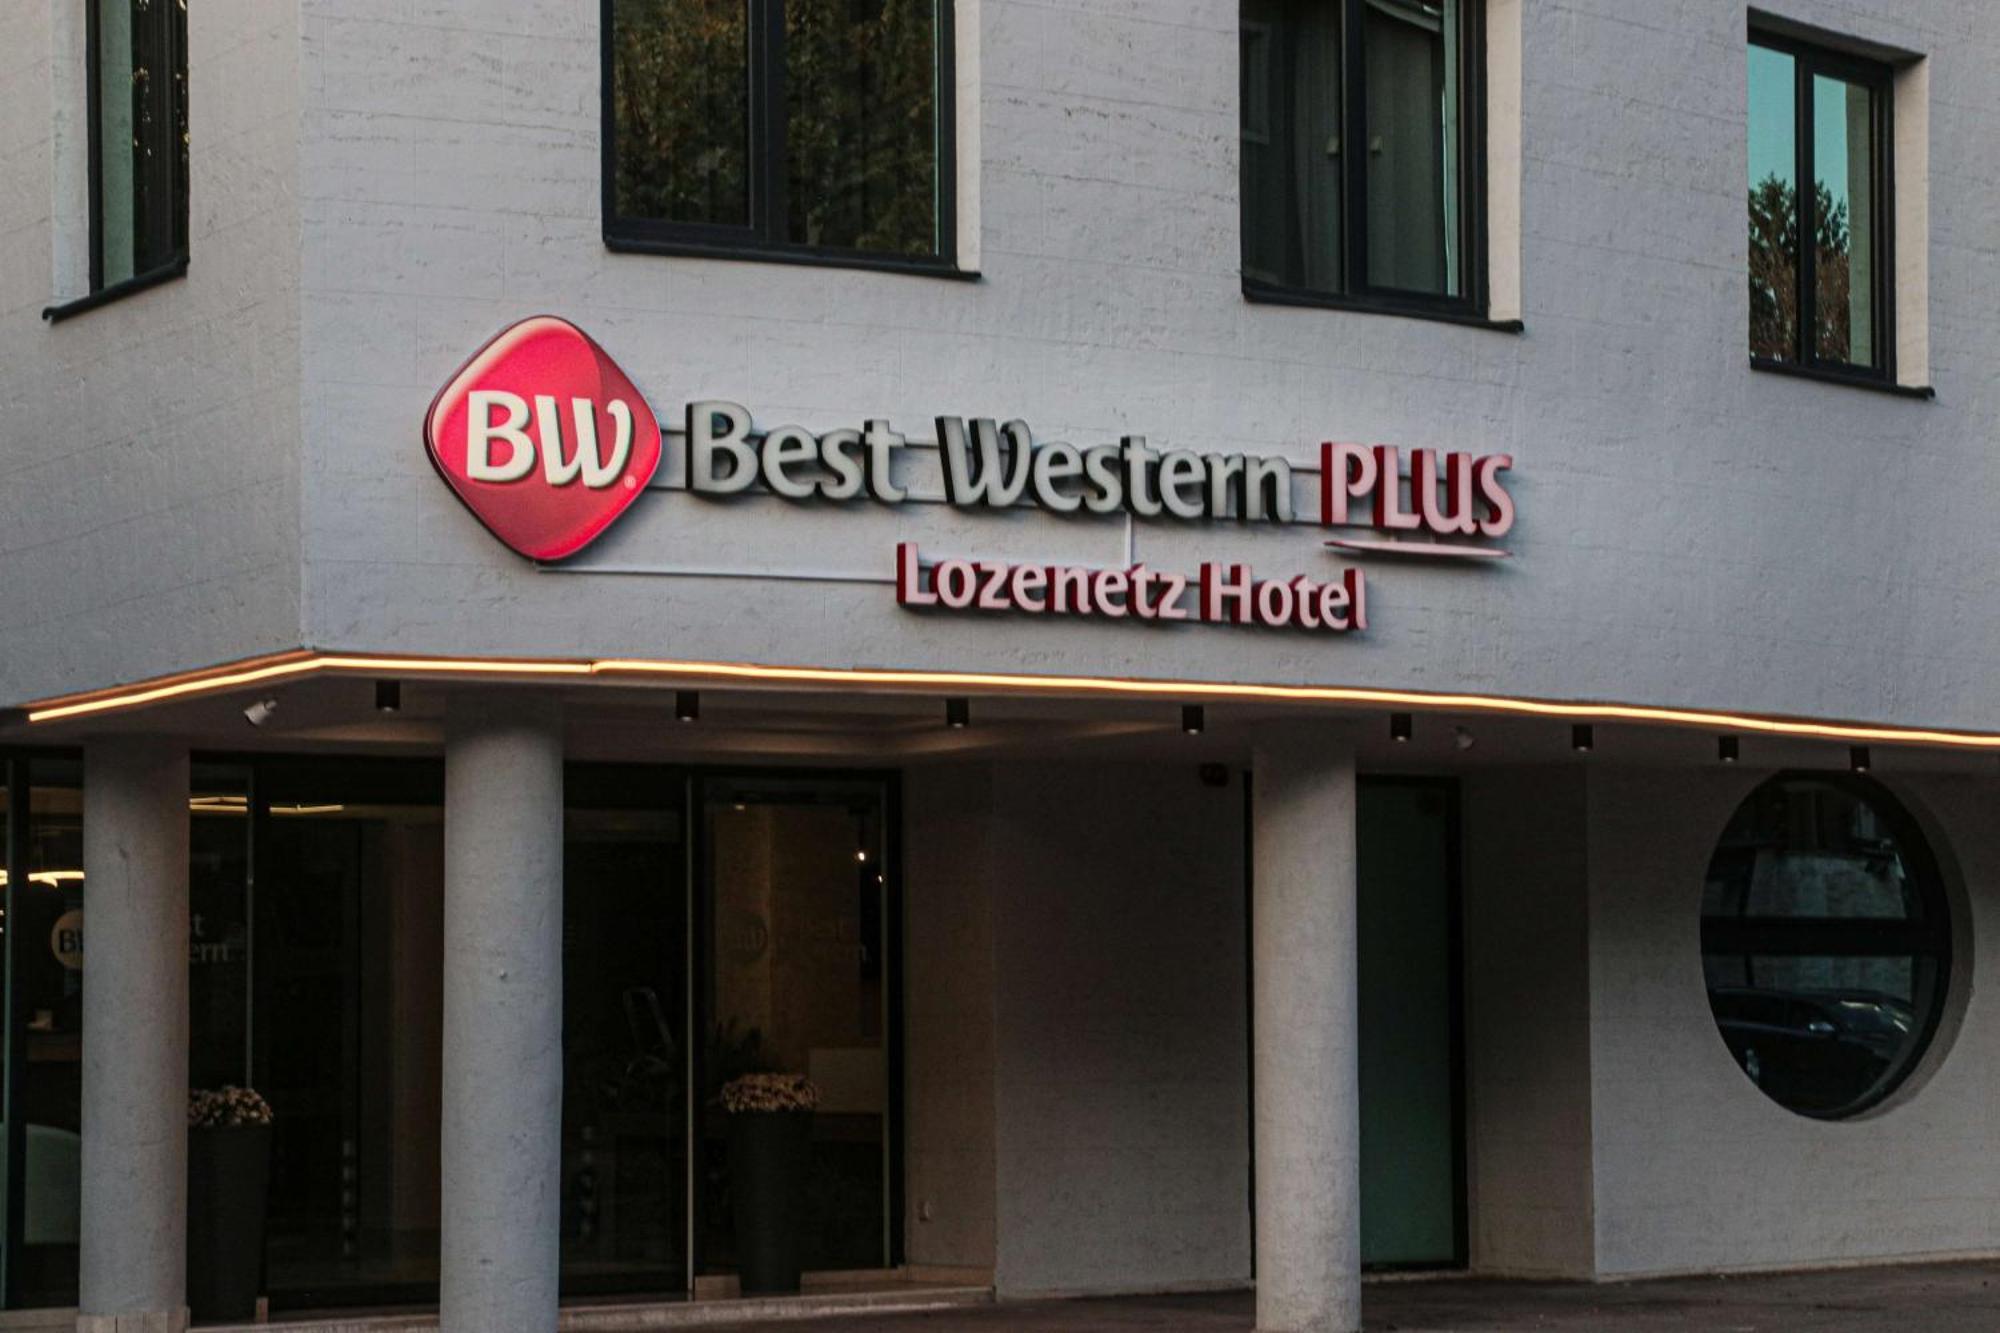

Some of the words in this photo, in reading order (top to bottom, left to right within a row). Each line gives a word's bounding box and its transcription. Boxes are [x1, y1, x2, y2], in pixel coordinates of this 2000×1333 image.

[685, 401, 907, 500] Best
[935, 415, 1296, 522] Western
[896, 542, 1187, 619] Lozenetz
[1201, 562, 1368, 631] Hotel
